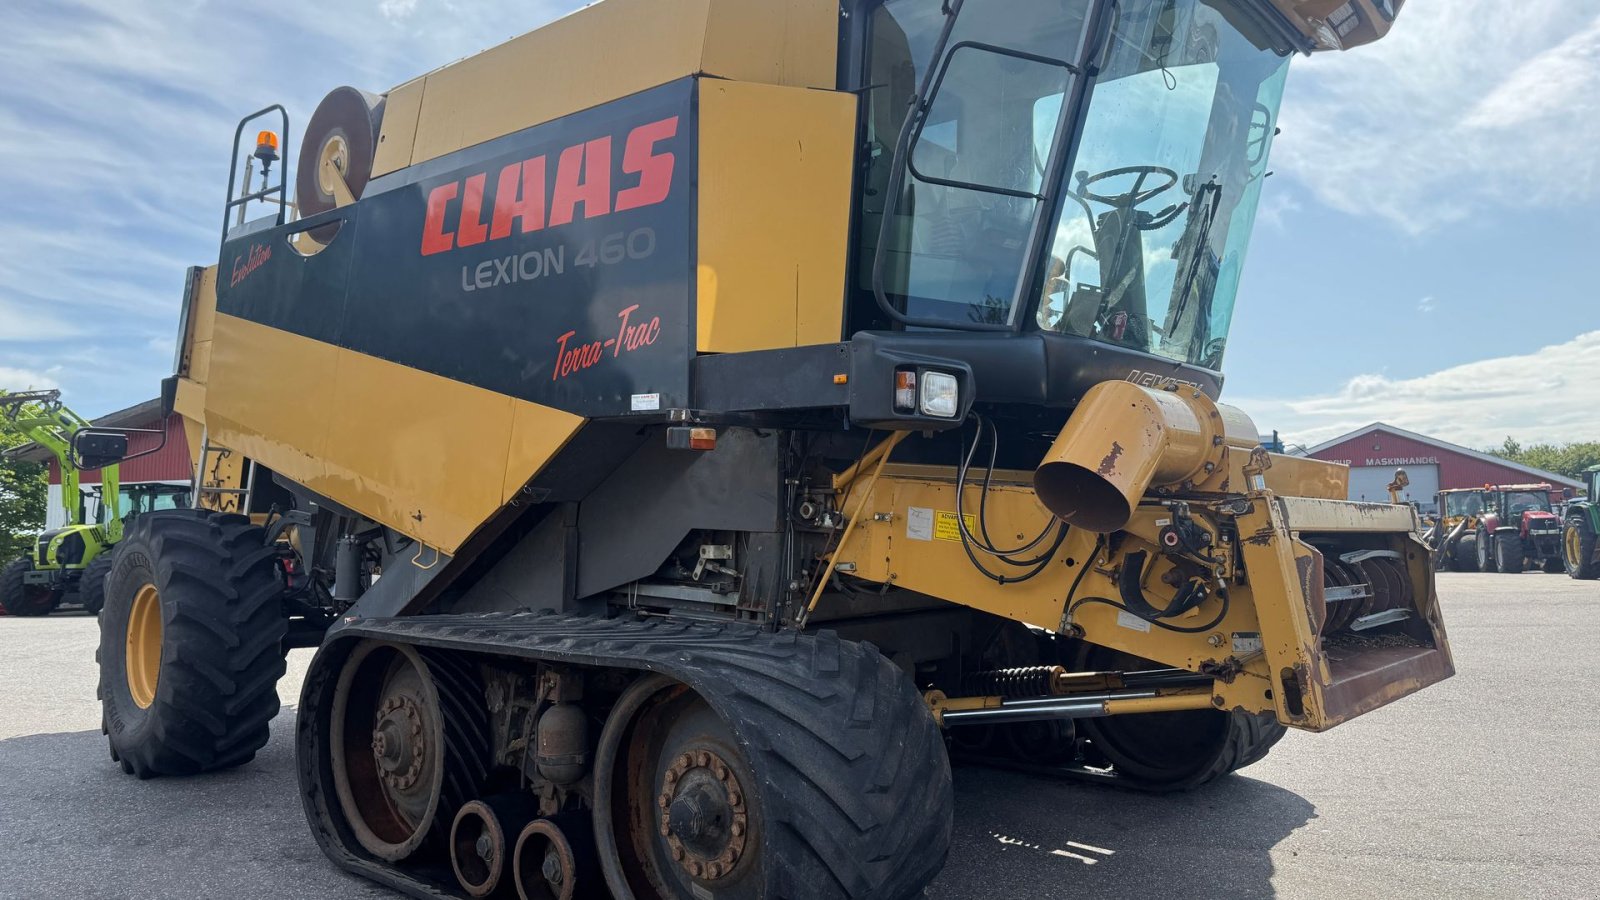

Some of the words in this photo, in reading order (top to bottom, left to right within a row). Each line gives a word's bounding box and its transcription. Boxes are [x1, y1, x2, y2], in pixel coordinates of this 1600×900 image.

[421, 116, 679, 256] CLAAS
[231, 243, 272, 288] Evolution
[462, 245, 564, 292] LEXION
[574, 227, 656, 269] 460
[553, 304, 660, 381] Terra-Trac
[1365, 456, 1440, 466] MASKINHANDEL
